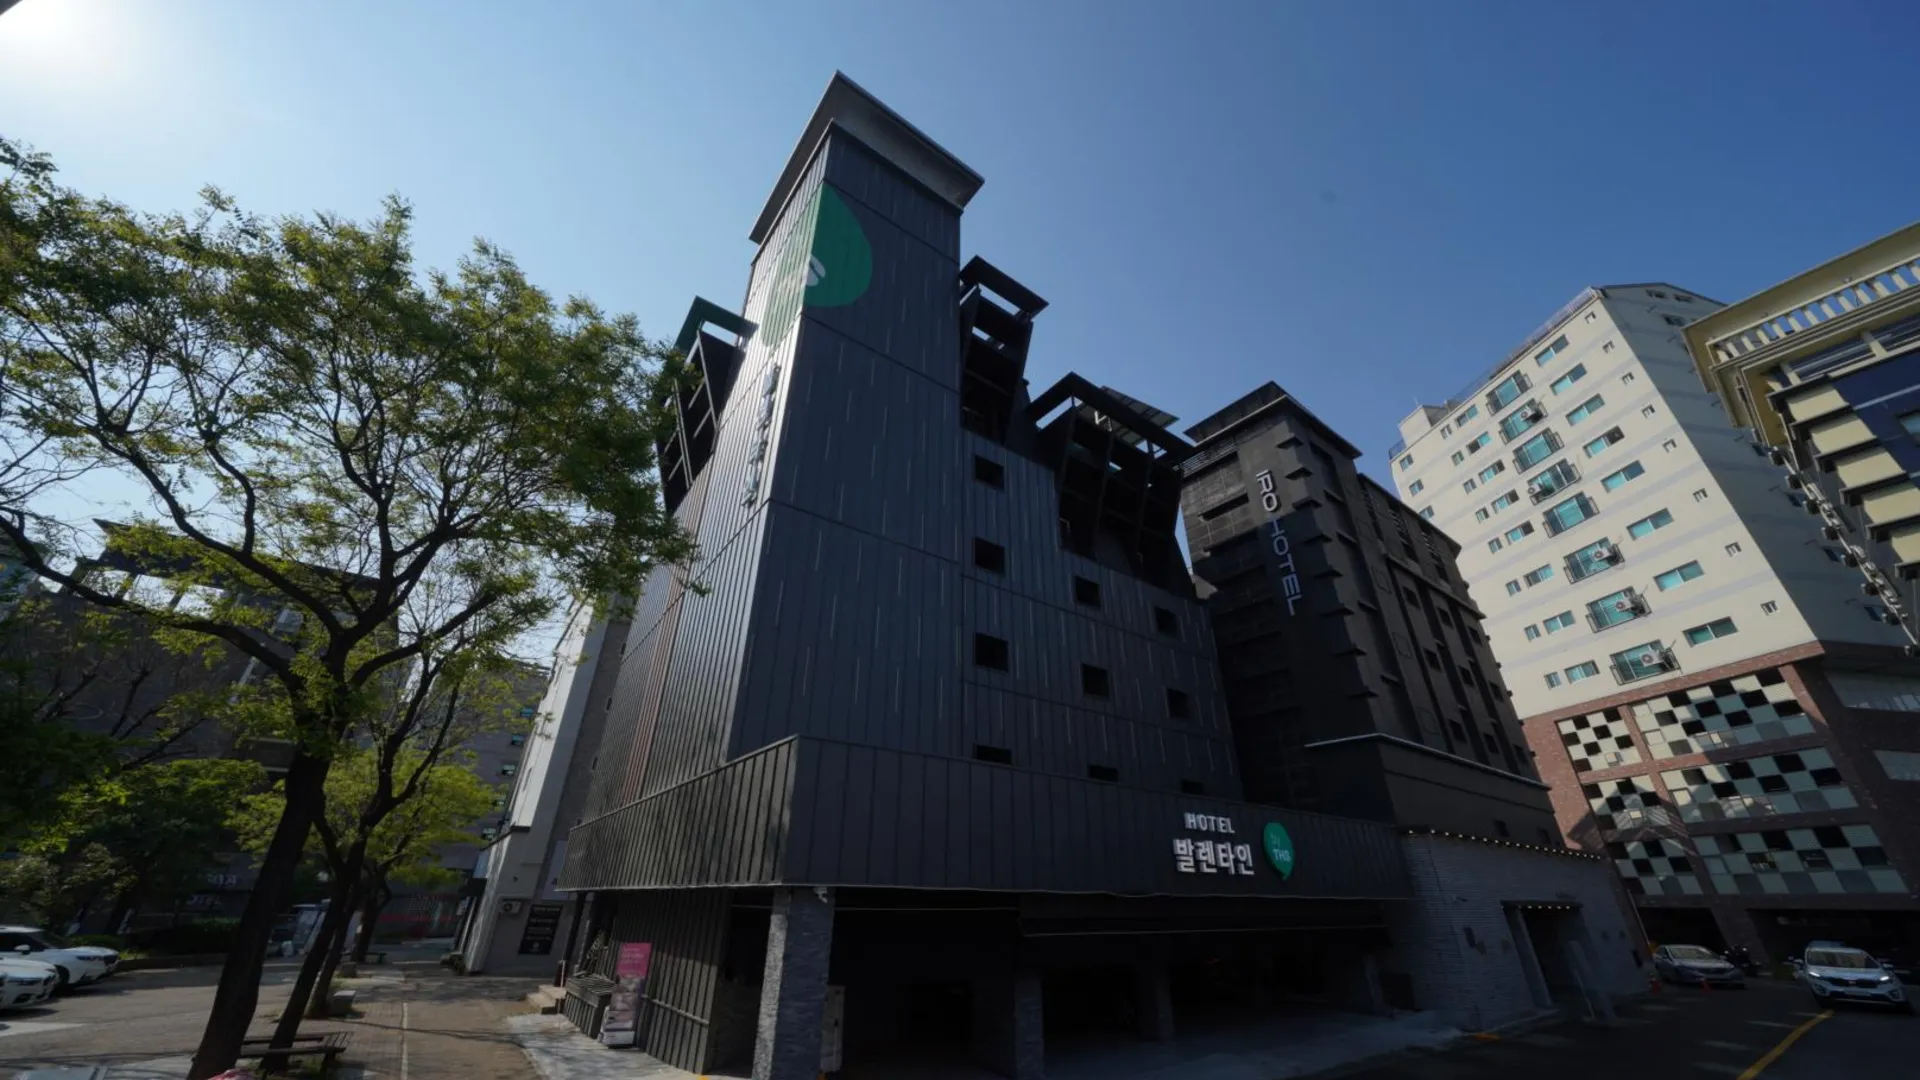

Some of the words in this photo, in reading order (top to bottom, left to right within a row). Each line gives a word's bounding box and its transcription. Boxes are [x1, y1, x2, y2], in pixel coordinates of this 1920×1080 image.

[1256, 469, 1278, 512] IRO
[1271, 517, 1302, 616] HOTEL
[1184, 812, 1236, 834] HOTEL
[1173, 838, 1255, 876] 발렌타인
